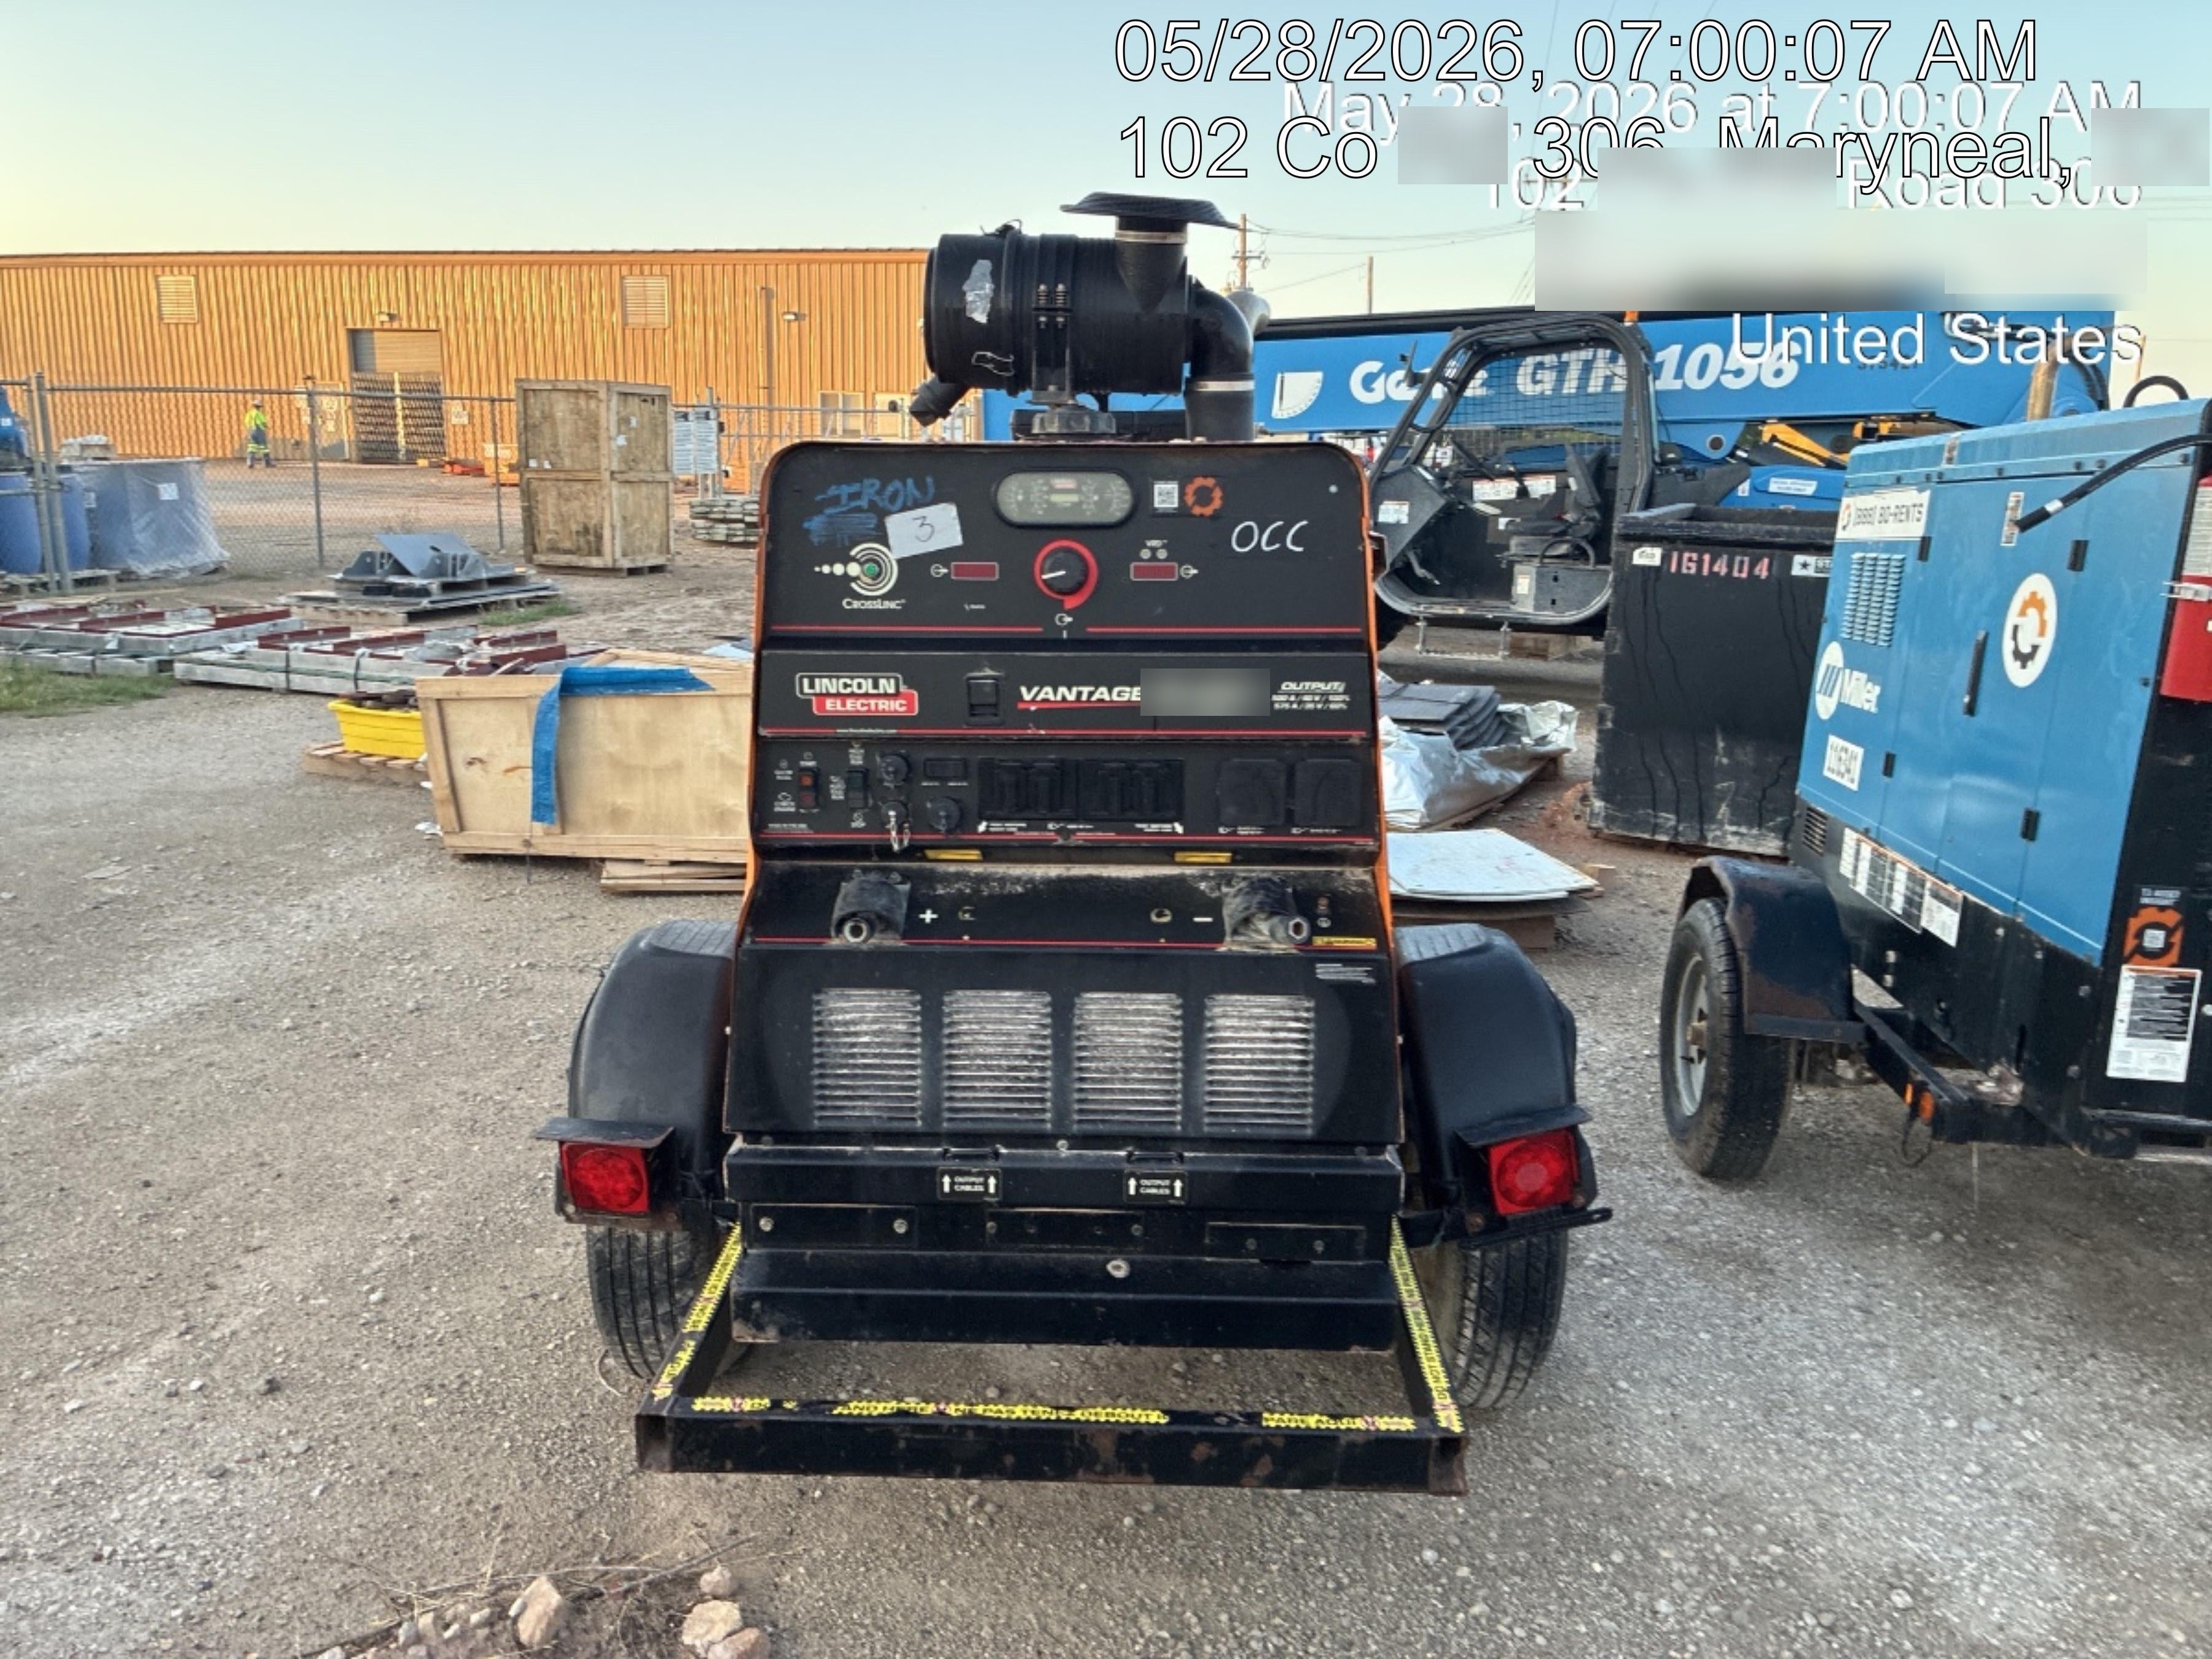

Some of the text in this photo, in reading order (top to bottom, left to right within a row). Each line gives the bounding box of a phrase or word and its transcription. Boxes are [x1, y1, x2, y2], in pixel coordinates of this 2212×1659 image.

[1655, 341, 1802, 390] 1056
[913, 516, 936, 543] 3
[802, 677, 896, 695] LINCOLN
[1281, 681, 1342, 690] OUTPUT
[825, 699, 908, 713] ELECTRIC
